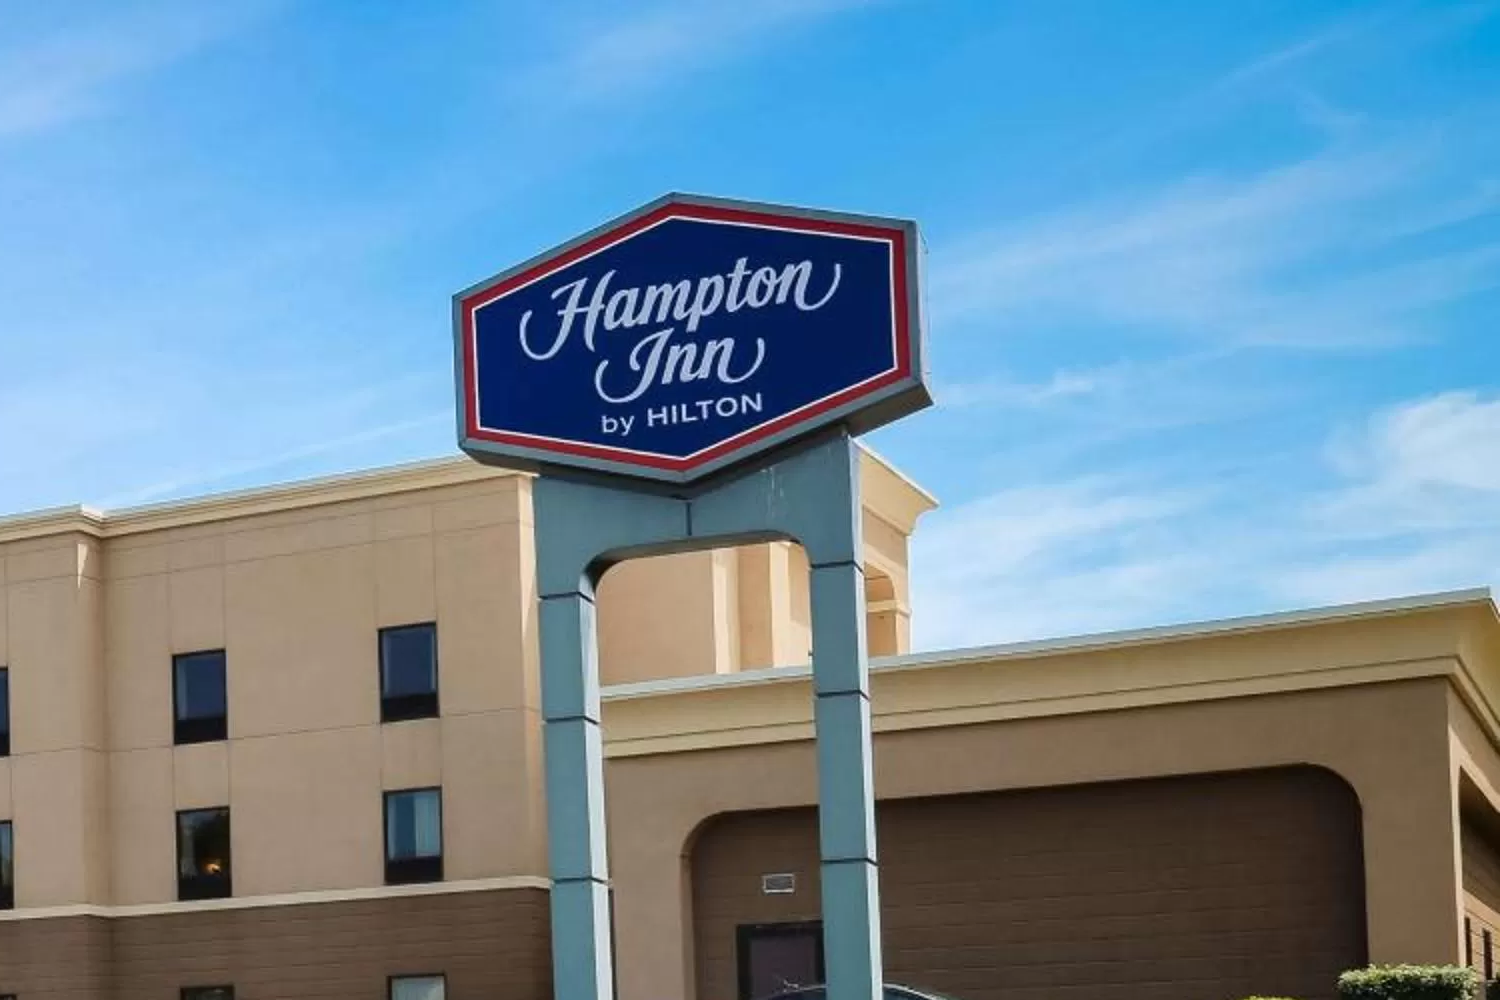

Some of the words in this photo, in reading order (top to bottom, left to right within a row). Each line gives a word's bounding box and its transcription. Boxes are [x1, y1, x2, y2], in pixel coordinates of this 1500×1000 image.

[519, 257, 843, 361] Hampton
[595, 328, 766, 404] Inn
[601, 414, 635, 436] by
[647, 391, 764, 428] HILTON
